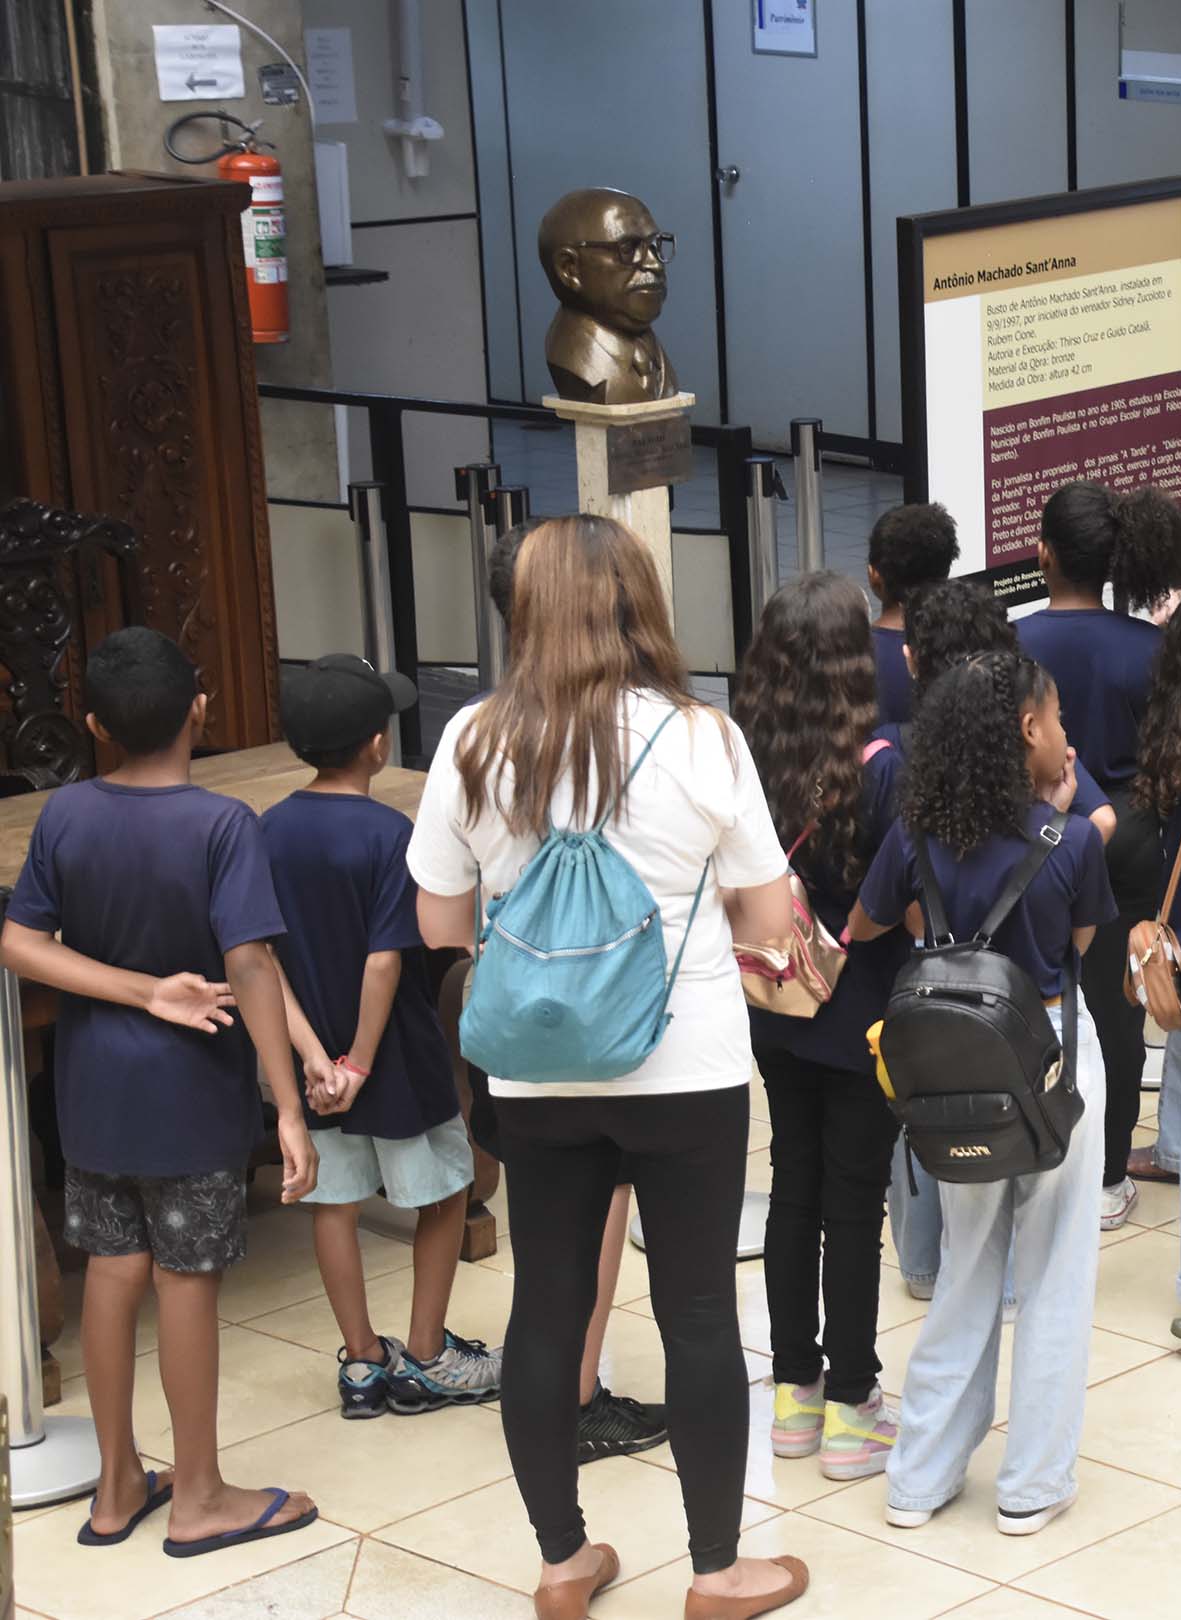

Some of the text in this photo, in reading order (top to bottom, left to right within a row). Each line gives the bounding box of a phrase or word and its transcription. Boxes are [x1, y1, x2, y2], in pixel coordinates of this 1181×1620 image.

[933, 272, 975, 291] Antônio
[977, 263, 1024, 284] Machado
[986, 304, 1008, 316] Busto
[1008, 301, 1019, 313] de
[1019, 295, 1048, 310] Antônio
[1049, 290, 1081, 304] Machado
[1120, 277, 1151, 291] instalada
[1151, 276, 1163, 286] em
[986, 289, 1172, 332] 9/9/1997, por iniciativa do vereador Sidney Zucoloto e
[987, 334, 1013, 347] Rubem
[987, 349, 1014, 361] Autoria
[1015, 347, 1021, 357] e
[1022, 339, 1057, 356] Execução:
[1059, 335, 1082, 348] Thirso
[1082, 332, 1099, 344] Cruz
[1100, 331, 1106, 341] e
[1106, 326, 1127, 339] Guido
[988, 361, 1017, 377] Material
[1018, 360, 1028, 372] da
[1051, 352, 1076, 366] bronze
[988, 363, 1093, 393] Medida da Obra: altura 42 cm
[990, 423, 1016, 437] Nascido
[1016, 421, 1028, 432] em
[1028, 415, 1051, 429] Bonfim
[1052, 410, 1077, 424] Paulista
[1077, 408, 1086, 418] no
[1087, 405, 1100, 416] ano
[1100, 402, 1109, 413] de
[1128, 394, 1153, 408] estudou
[1153, 392, 1162, 402] na
[990, 434, 1021, 450] Municipal
[1021, 433, 1031, 444] de
[1032, 427, 1056, 441] Bonfim
[1056, 423, 1081, 435] Paulista
[1082, 421, 1088, 430] e
[1088, 419, 1098, 428] no
[1098, 414, 1119, 427] Grupo
[1119, 409, 1141, 422] Escolar
[1142, 404, 1161, 419] (atual
[991, 479, 1002, 490] Foi
[1003, 472, 1033, 489] jornalista
[1034, 471, 1041, 480] e
[1041, 461, 1079, 480] proprietário
[1083, 457, 1096, 469] dos
[1097, 453, 1119, 467] jornais
[1151, 444, 1157, 453] e
[991, 492, 1001, 503] da
[1027, 485, 1033, 495] e
[1032, 481, 1050, 493] entre
[1050, 479, 1059, 489] os
[1102, 468, 1108, 477] e
[1126, 459, 1151, 472] exerceu
[1150, 457, 1156, 466] o
[1156, 453, 1174, 465] cargo
[1026, 496, 1036, 508] Foi
[1113, 475, 1134, 487] diretor
[1138, 471, 1148, 481] do
[991, 518, 1002, 529] do
[1001, 514, 1024, 528] Rotary
[992, 530, 1010, 542] Preto
[1009, 529, 1015, 538] e
[1014, 523, 1036, 537] diretor
[992, 544, 1002, 555] da
[993, 577, 1014, 588] Projeto
[1013, 575, 1021, 583] de
[1016, 582, 1031, 592] Preto
[1030, 579, 1038, 588] de
